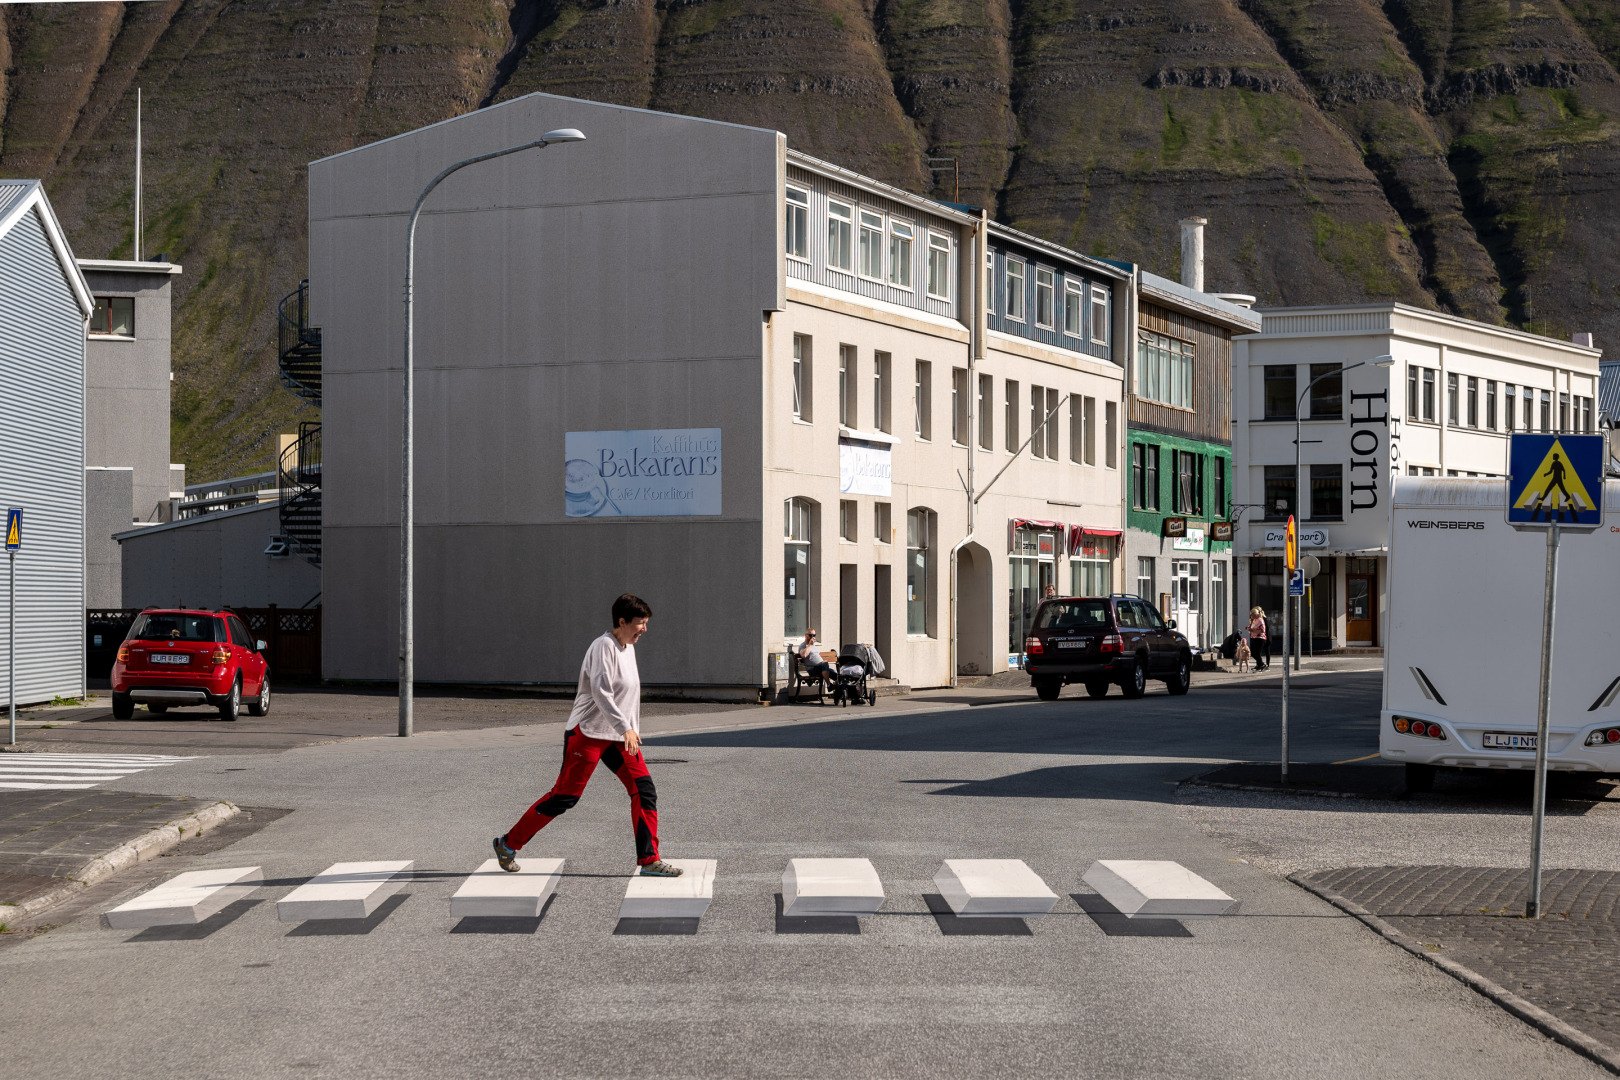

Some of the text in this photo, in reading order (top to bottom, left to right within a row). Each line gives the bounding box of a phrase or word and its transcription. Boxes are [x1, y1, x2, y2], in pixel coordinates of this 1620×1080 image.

[651, 434, 717, 454] Kaffihús
[1350, 388, 1387, 514] Horn
[598, 448, 717, 478] Bakarans
[643, 487, 694, 500] Konditori
[1407, 520, 1485, 530] WEINSBERG
[1289, 570, 1301, 586] P
[1495, 735, 1511, 746] LJ
